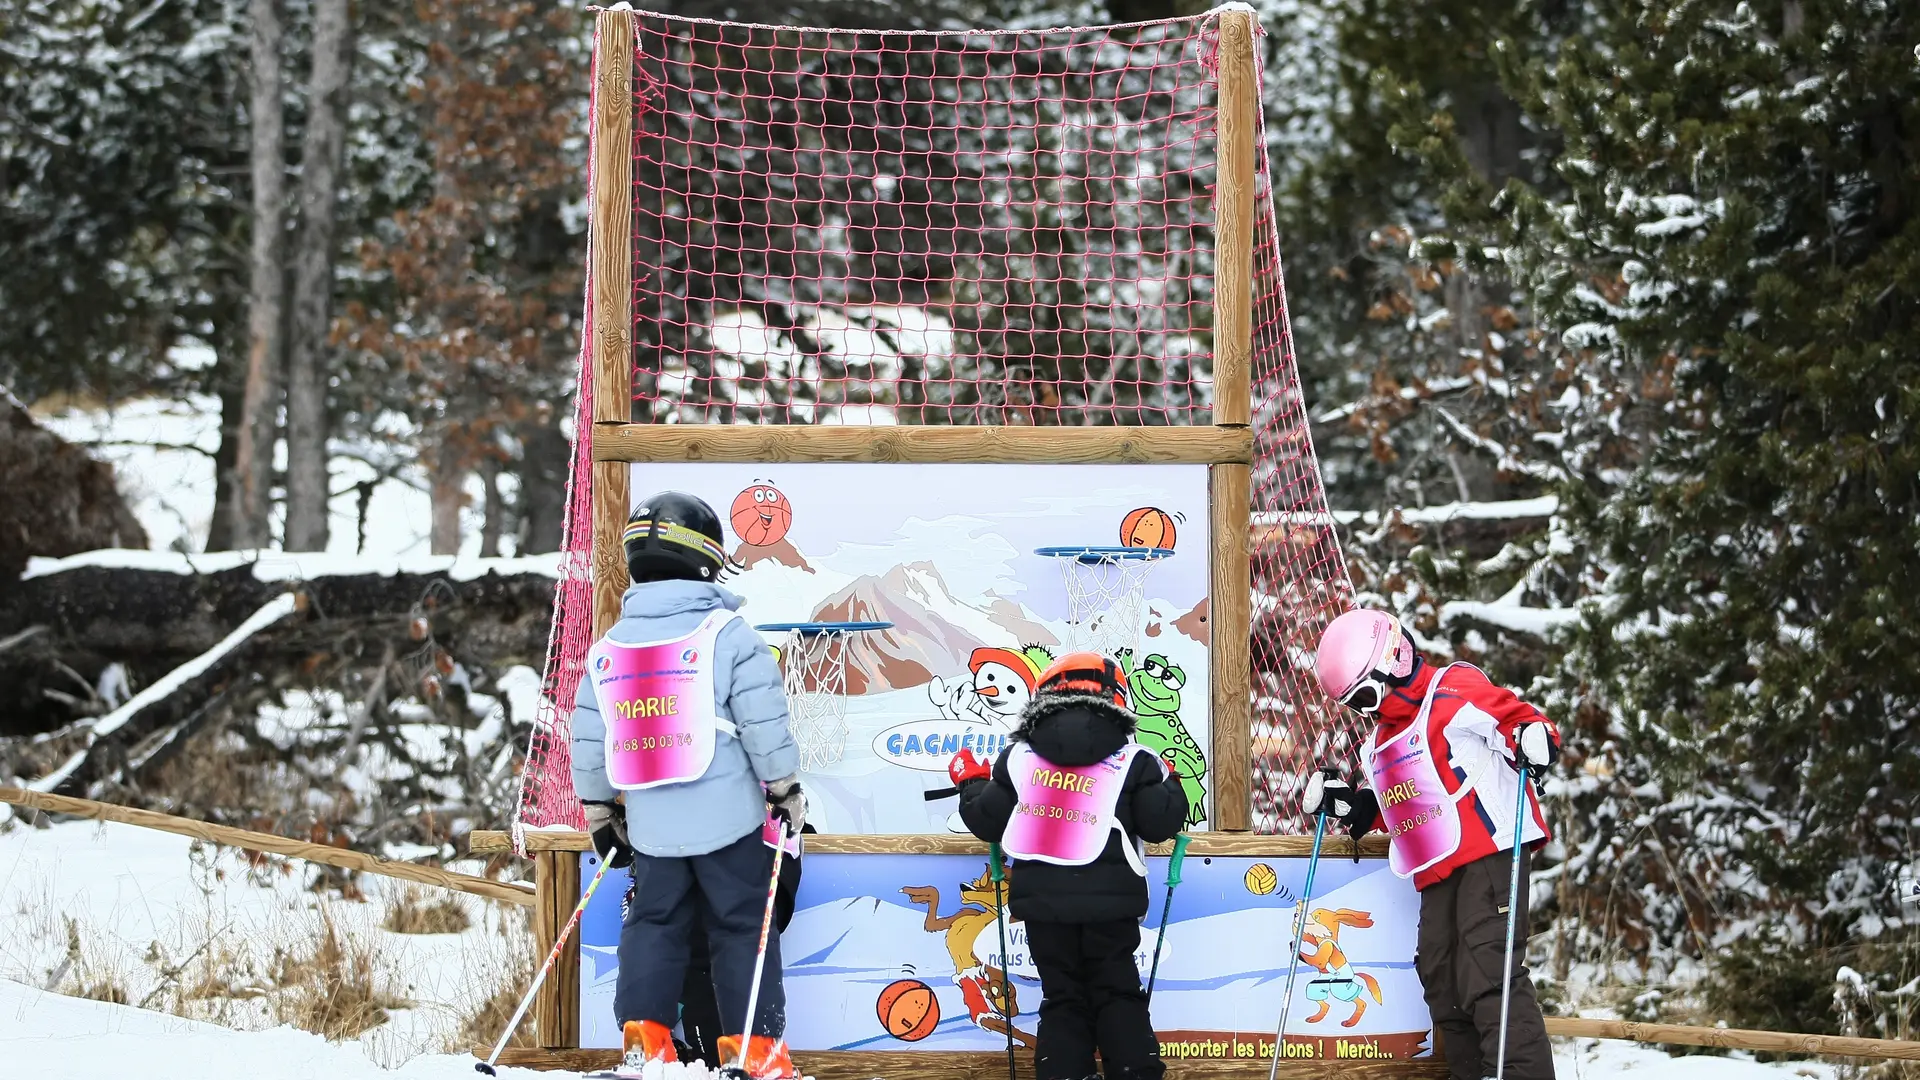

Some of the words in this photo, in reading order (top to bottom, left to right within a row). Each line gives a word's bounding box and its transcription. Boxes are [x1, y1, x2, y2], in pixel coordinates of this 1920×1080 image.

[615, 695, 678, 721] MARIE
[623, 738, 639, 751] 68
[642, 736, 656, 749] 30
[659, 734, 674, 748] 03
[676, 732, 693, 746] 74
[886, 726, 1007, 757] GAGNÉ!!!
[1032, 767, 1097, 796] MARIE
[1017, 801, 1030, 815] 04
[1032, 803, 1046, 817] 68
[1048, 806, 1063, 819] 30
[1066, 809, 1080, 822] 03
[1082, 811, 1097, 826] 74
[1401, 818, 1414, 832] 30
[1415, 812, 1428, 826] 03
[1429, 804, 1443, 820] 74
[1232, 1038, 1255, 1057] les
[1318, 1039, 1323, 1058] !
[1336, 1039, 1393, 1059] Merci...
